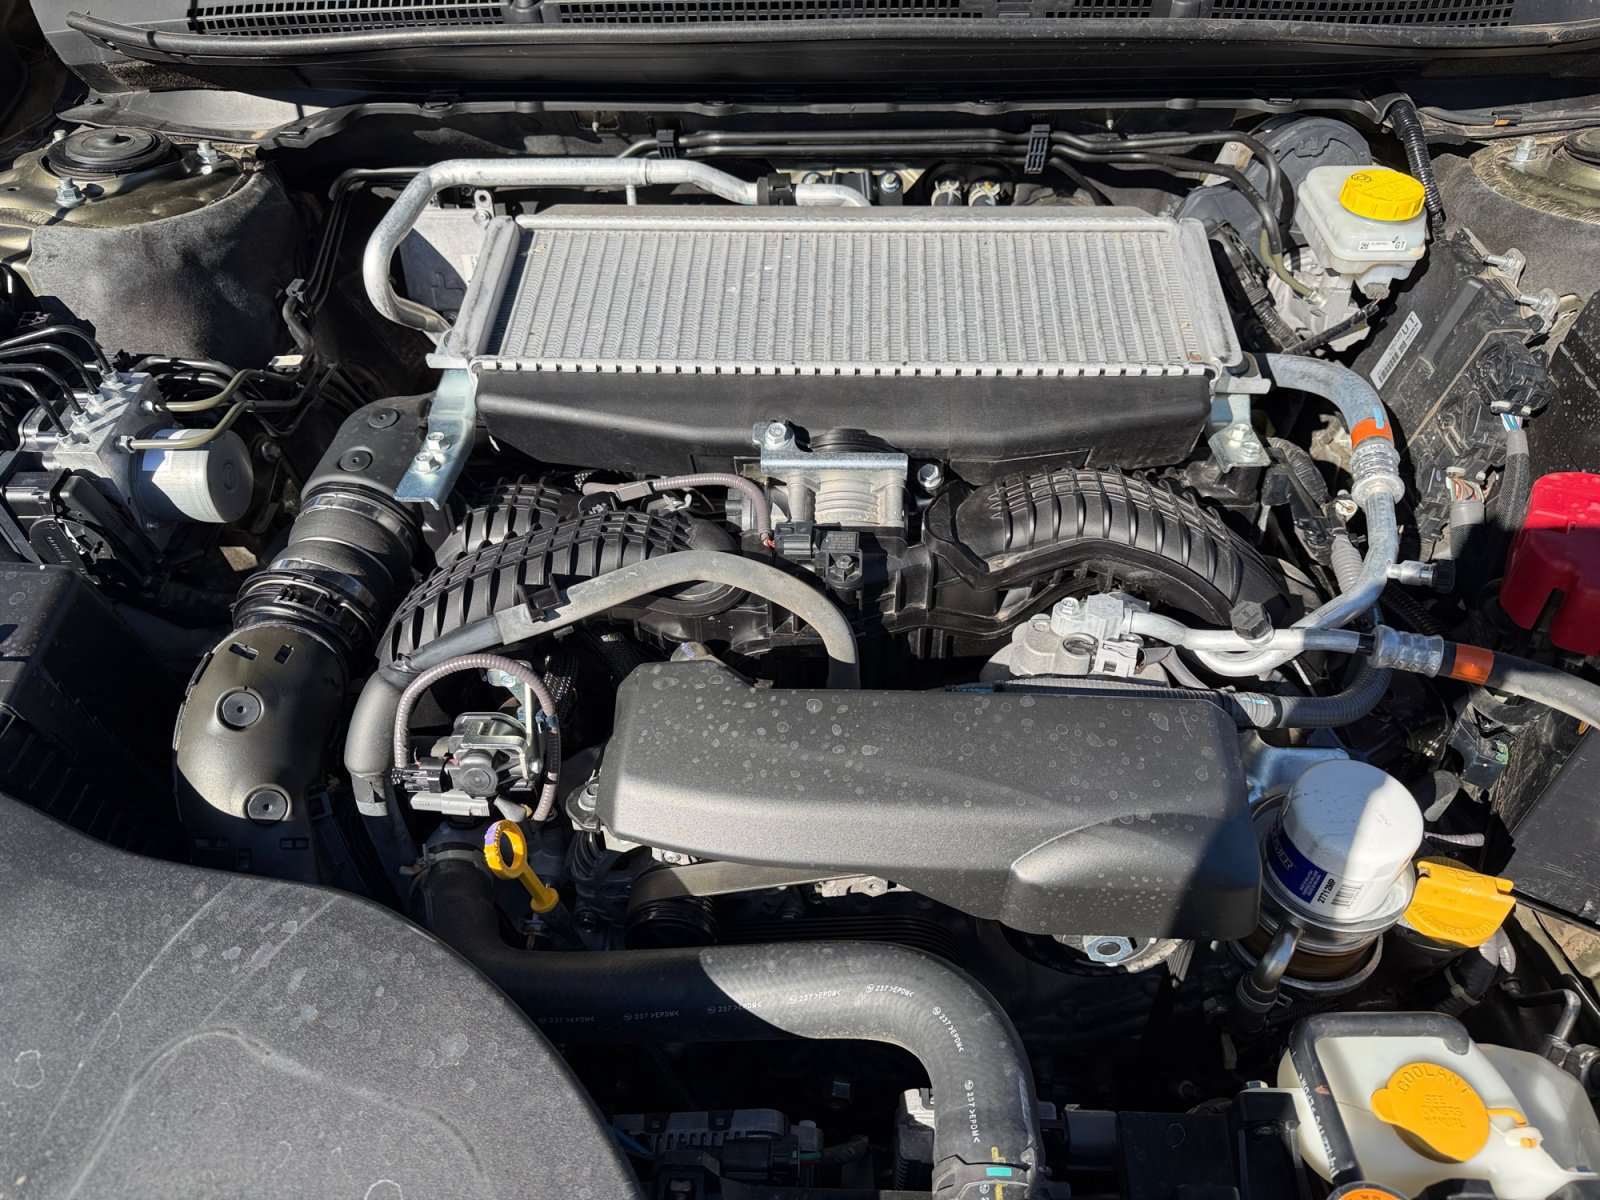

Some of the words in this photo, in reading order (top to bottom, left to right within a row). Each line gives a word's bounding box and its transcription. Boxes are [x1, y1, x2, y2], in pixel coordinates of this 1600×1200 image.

[873, 983, 890, 993] 237
[798, 992, 813, 1003] 237
[937, 1012, 952, 1027] 237
[1396, 1064, 1473, 1094] COOLANT
[966, 1091, 976, 1108] 237
